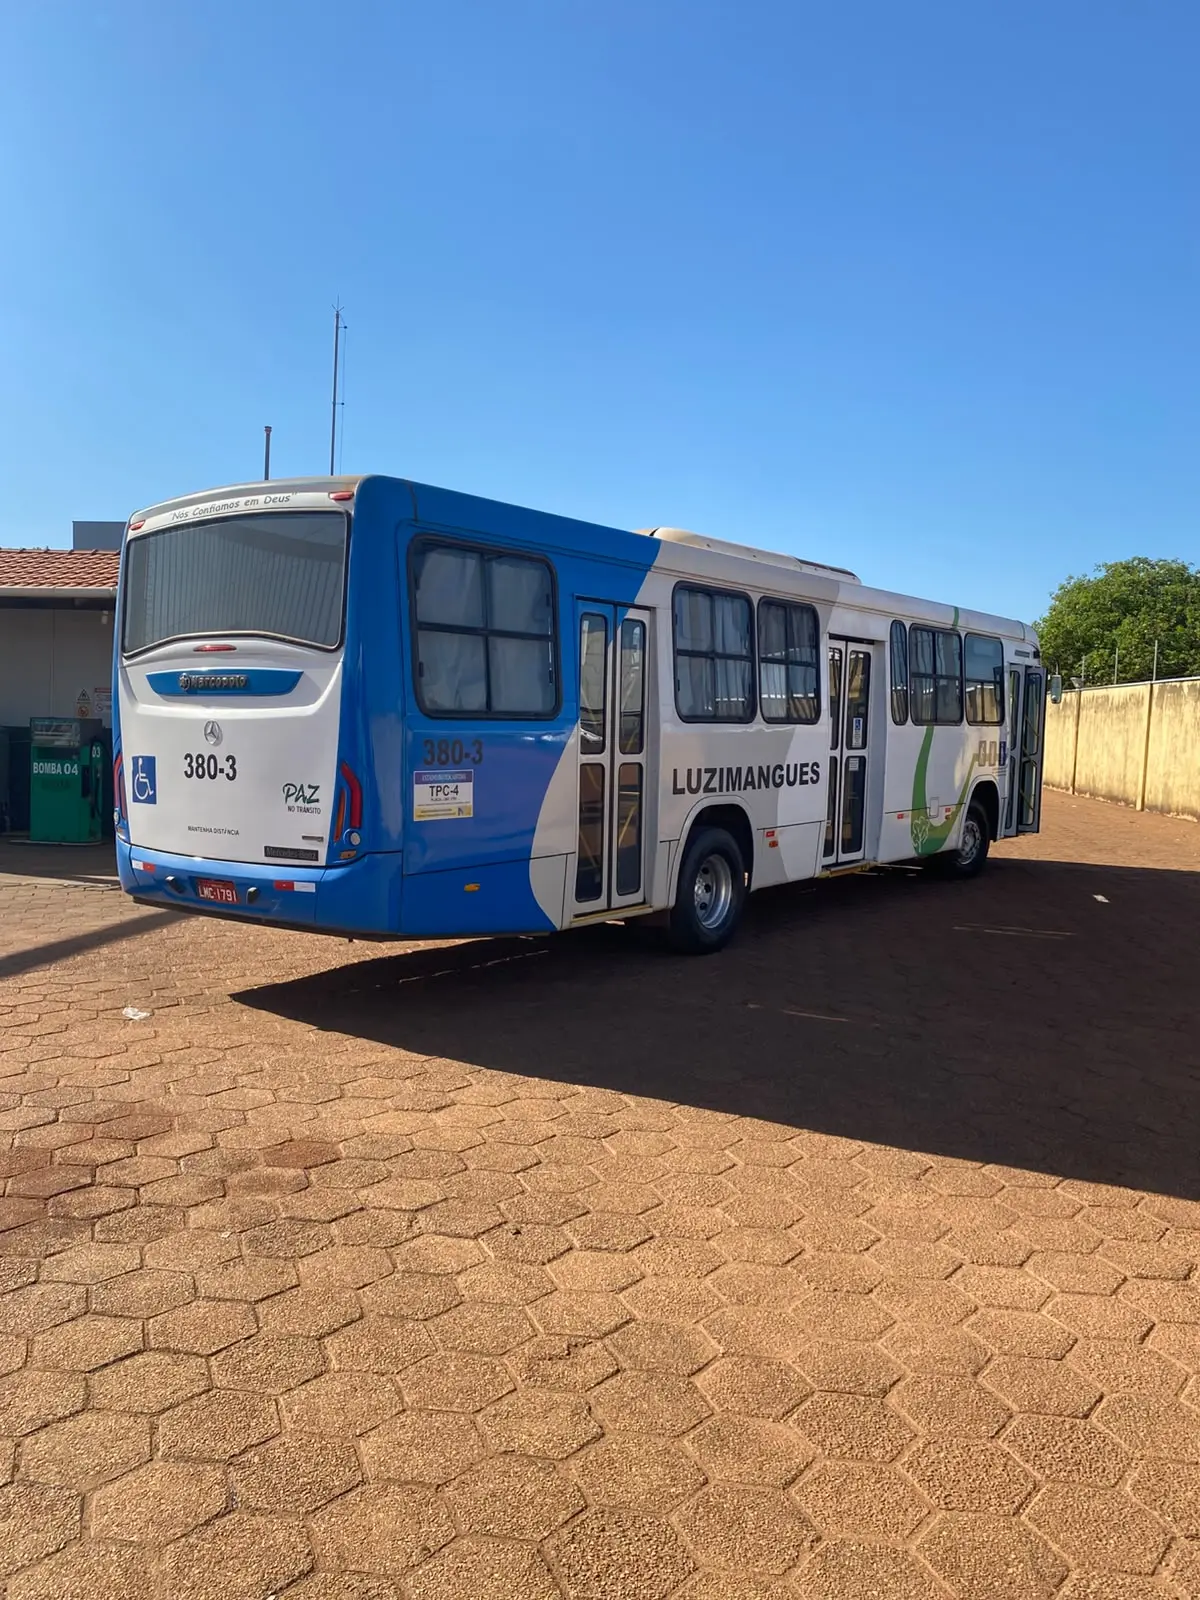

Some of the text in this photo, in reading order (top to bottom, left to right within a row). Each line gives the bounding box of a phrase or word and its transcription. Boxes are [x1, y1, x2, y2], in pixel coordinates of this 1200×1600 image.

[192, 500, 240, 517] Confiamos
[244, 498, 259, 507] em
[422, 738, 483, 767] 380-3
[32, 762, 79, 776] BOMBA 04
[183, 752, 237, 781] 380-3
[672, 761, 820, 795] LUZIMANGUES
[282, 783, 320, 804] PAZ
[428, 784, 460, 797] TPC-4
[287, 805, 296, 813] NO
